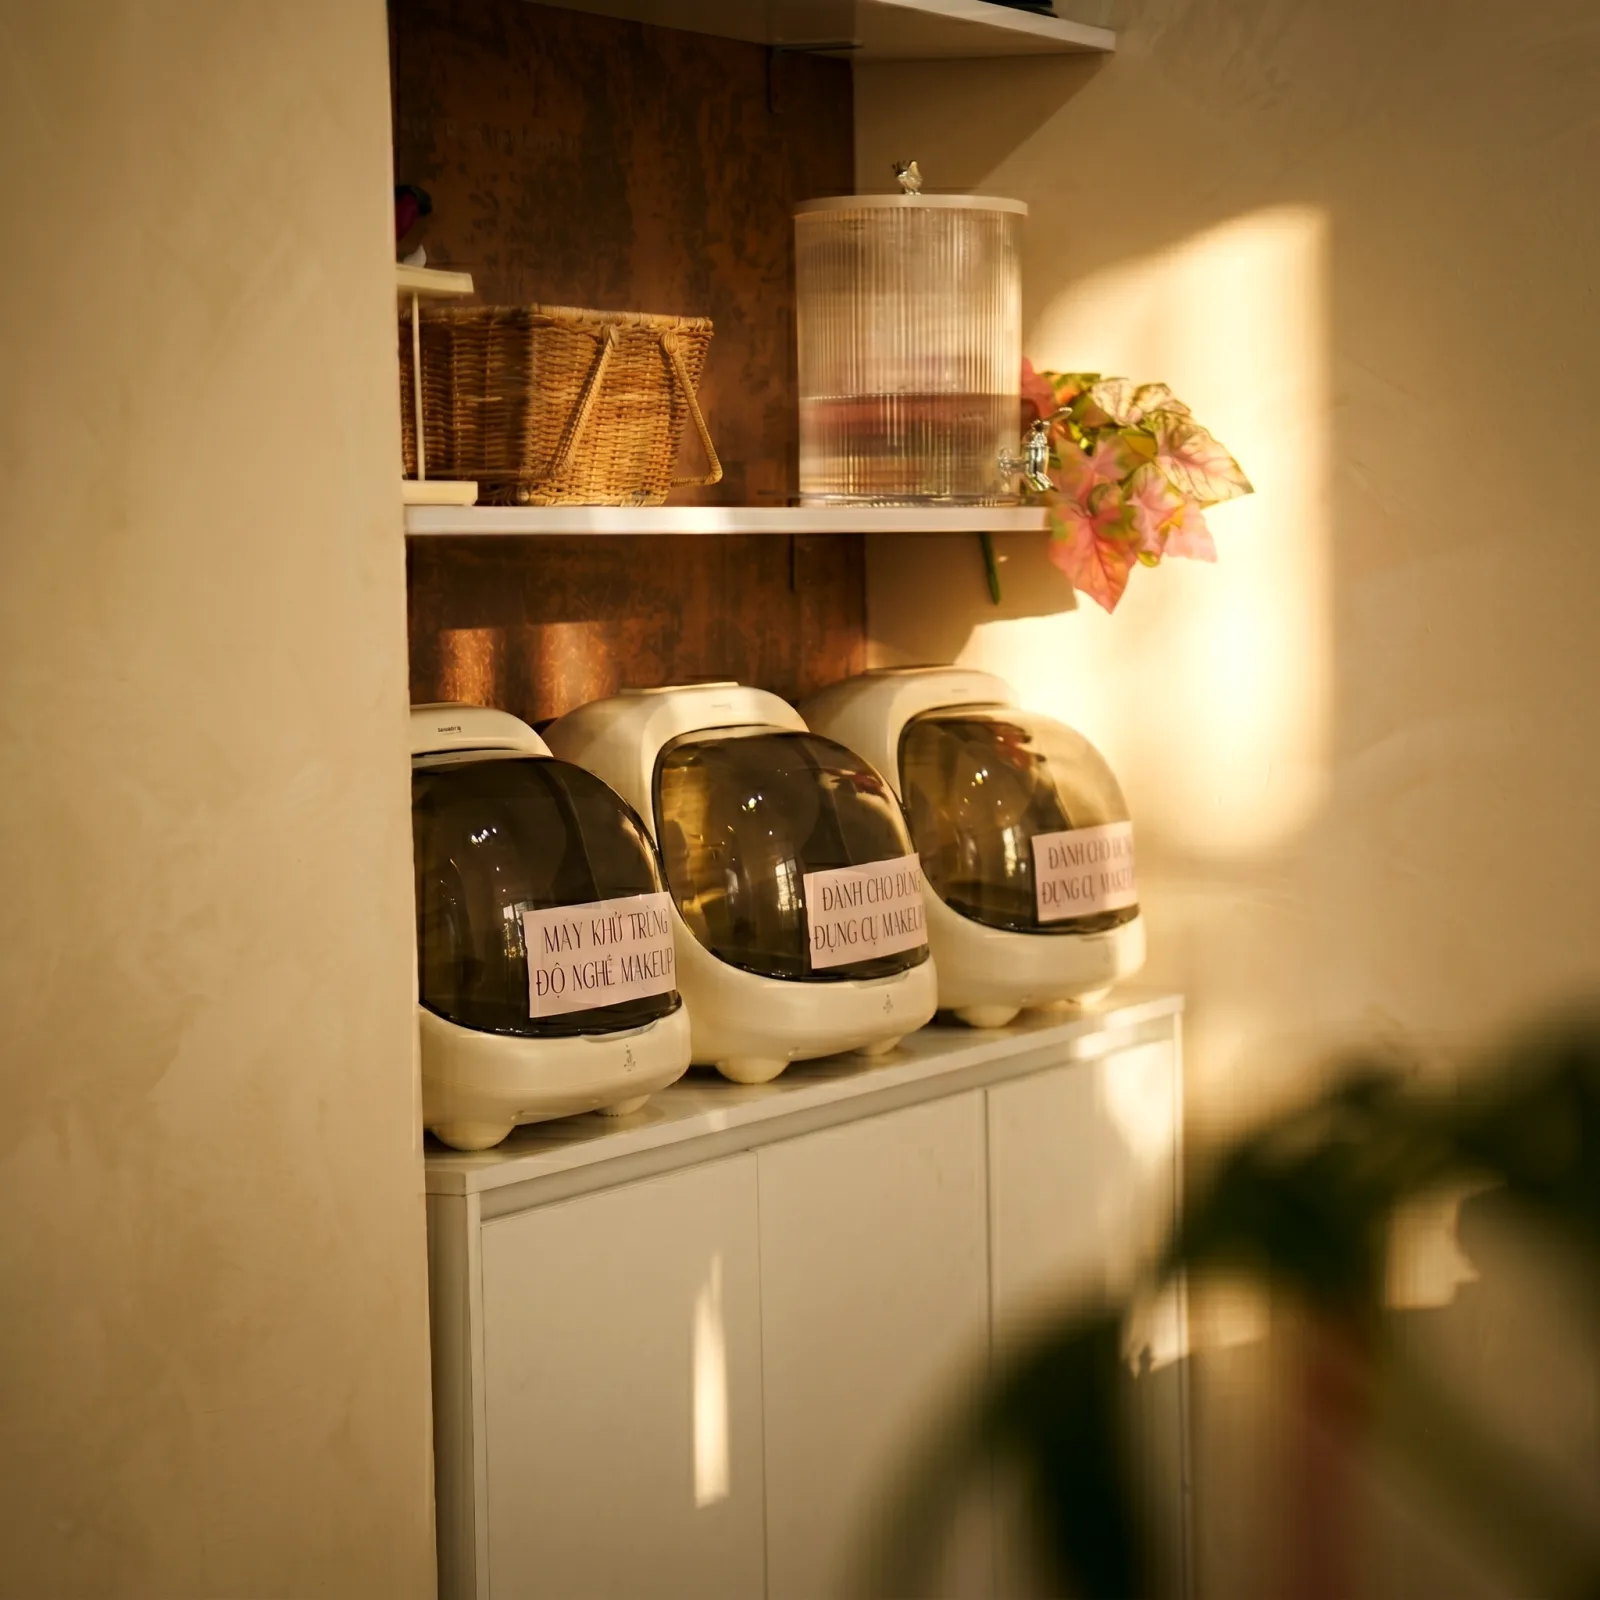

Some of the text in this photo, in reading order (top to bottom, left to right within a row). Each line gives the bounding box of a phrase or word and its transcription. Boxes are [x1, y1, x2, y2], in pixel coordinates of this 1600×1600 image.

[867, 876, 893, 903] CHO
[544, 906, 668, 953] MÁY KHỬ TRÙNG
[814, 920, 858, 952] ĐỤNG
[861, 916, 878, 945] CỤ
[621, 947, 673, 983] MAKEUP
